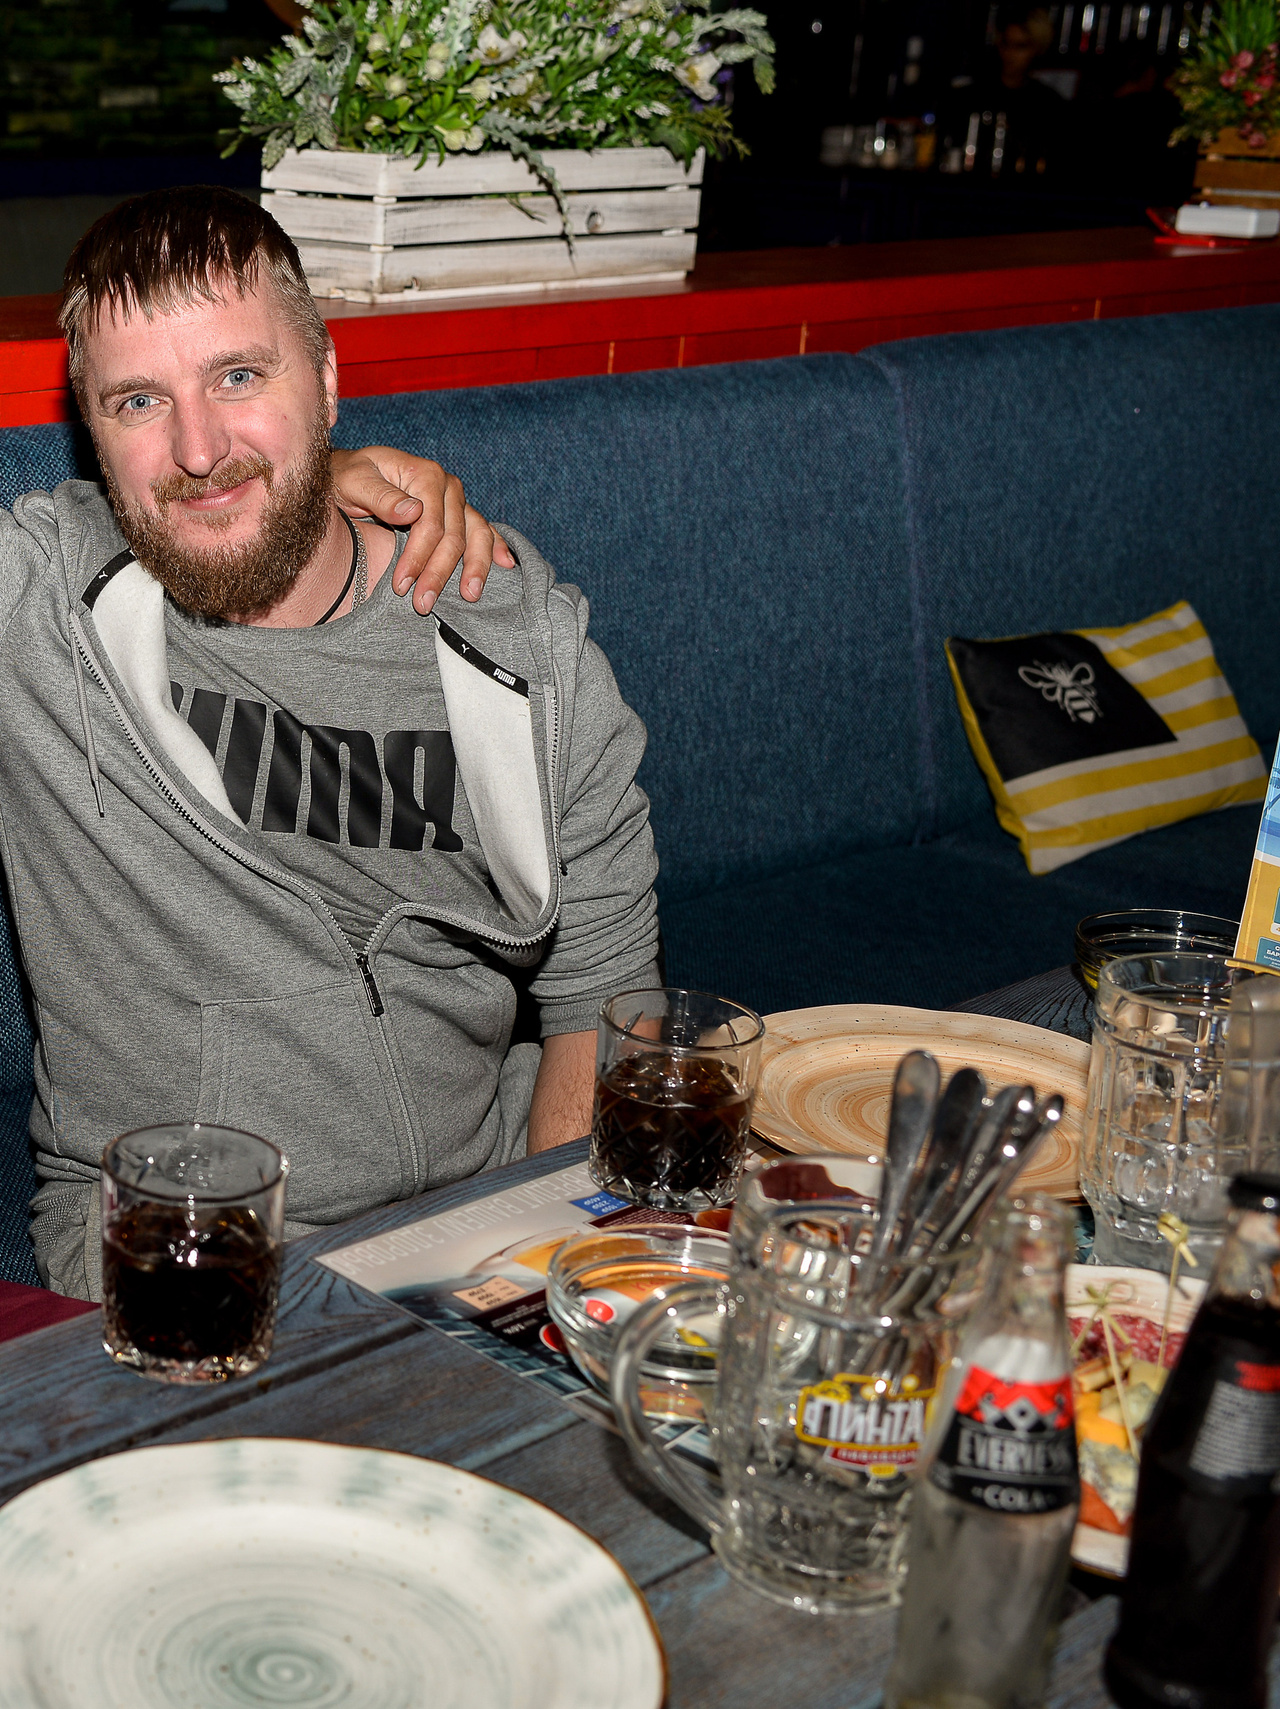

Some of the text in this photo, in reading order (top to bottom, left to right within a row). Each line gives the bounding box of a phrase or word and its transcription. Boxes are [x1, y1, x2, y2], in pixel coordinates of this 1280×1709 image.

[493, 667, 517, 687] PUMA
[170, 680, 464, 852] UMA
[326, 1171, 592, 1276] ВРЕДИТ ВАШЕМУ ЗДОРОВЬЮ
